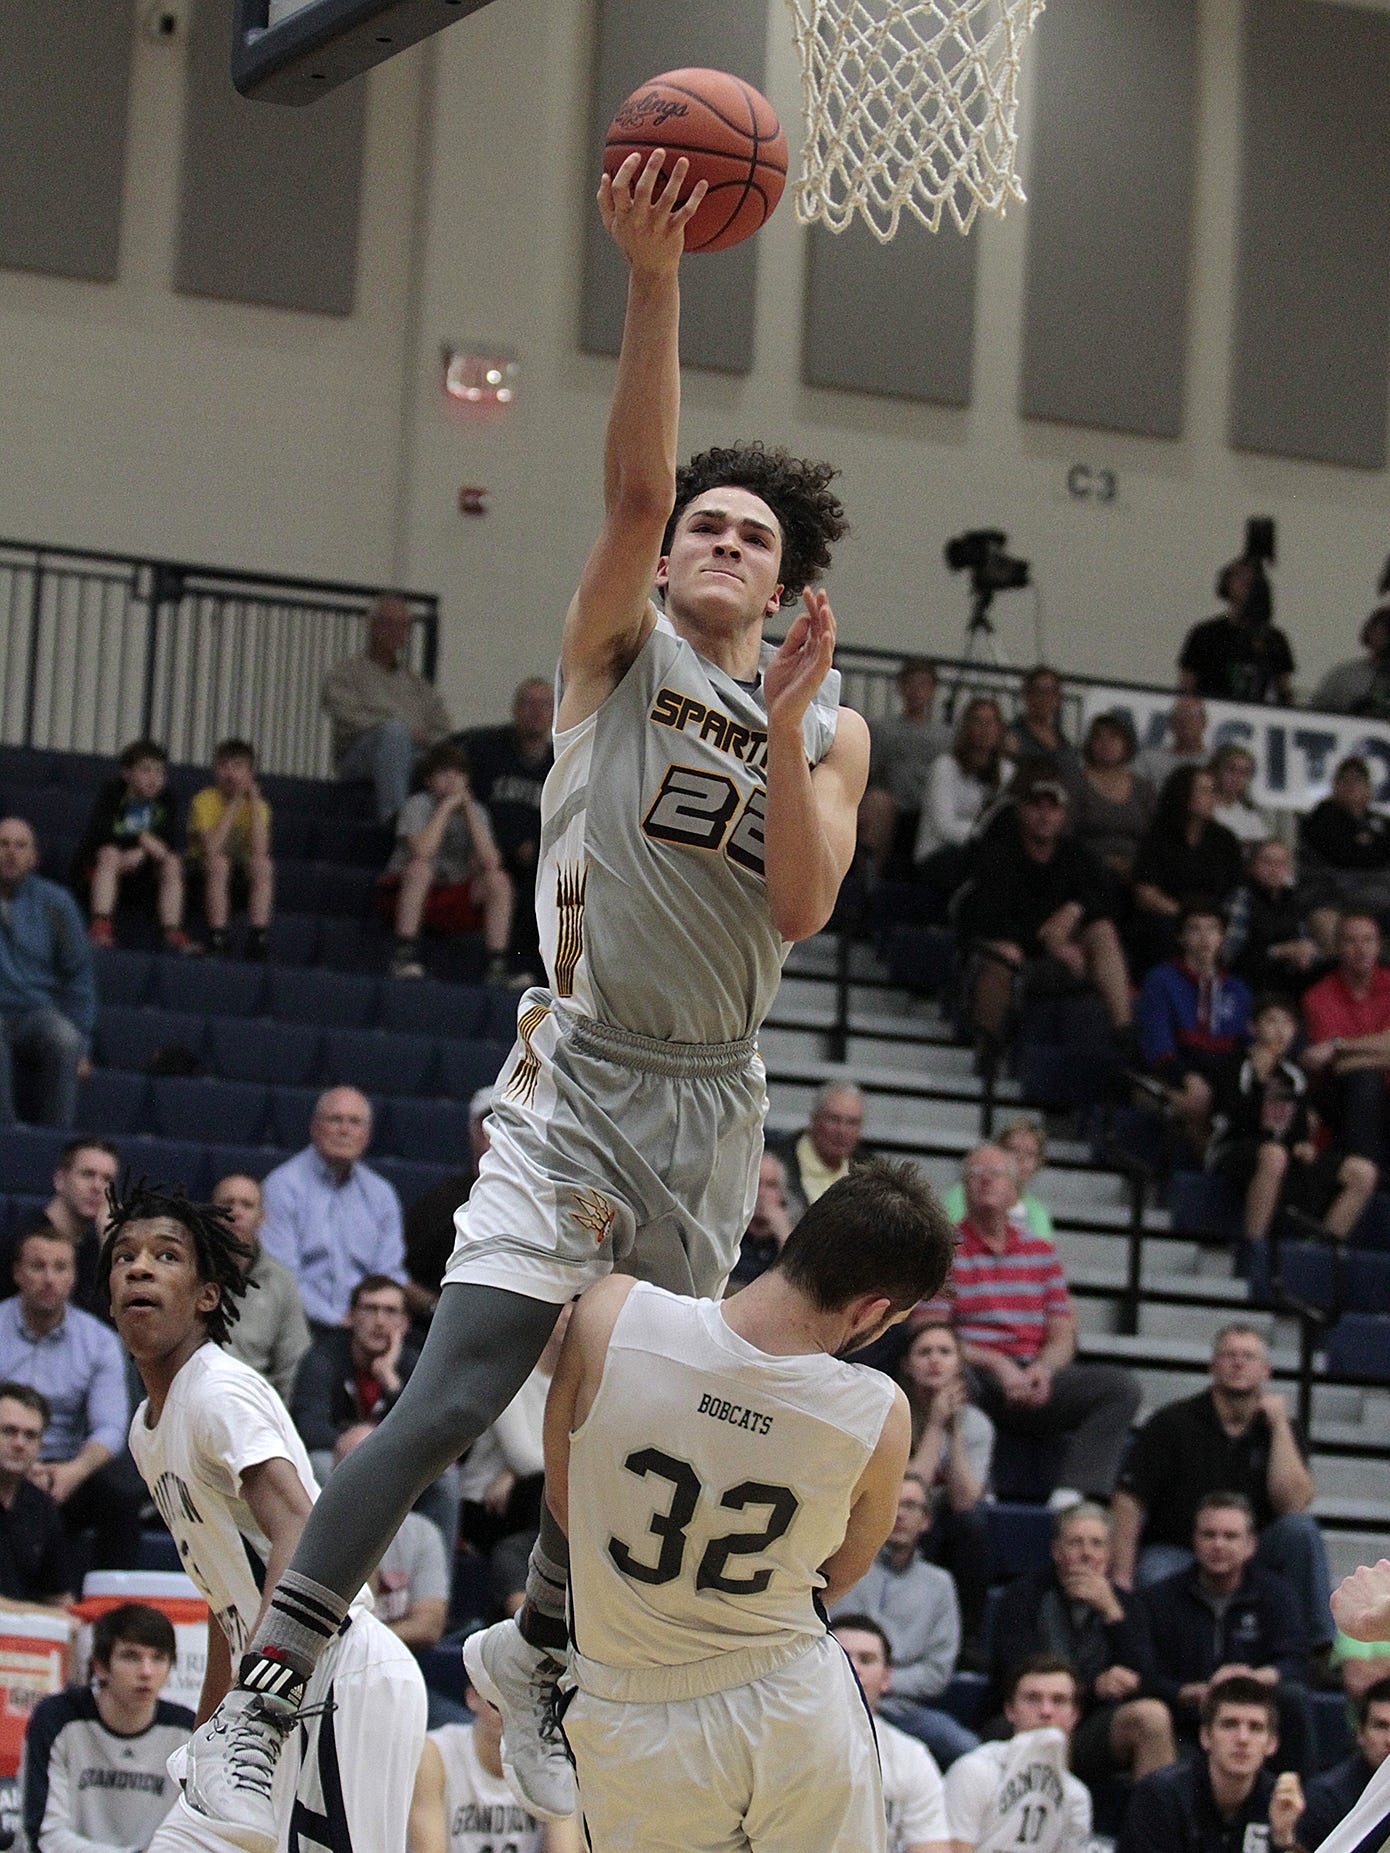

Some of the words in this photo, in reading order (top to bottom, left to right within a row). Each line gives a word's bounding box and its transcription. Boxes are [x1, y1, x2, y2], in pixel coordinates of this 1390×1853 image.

[1067, 463, 1117, 502] C3
[650, 687, 768, 770] SPART
[697, 1393, 774, 1436] BOBCATS
[607, 1446, 800, 1596] 32
